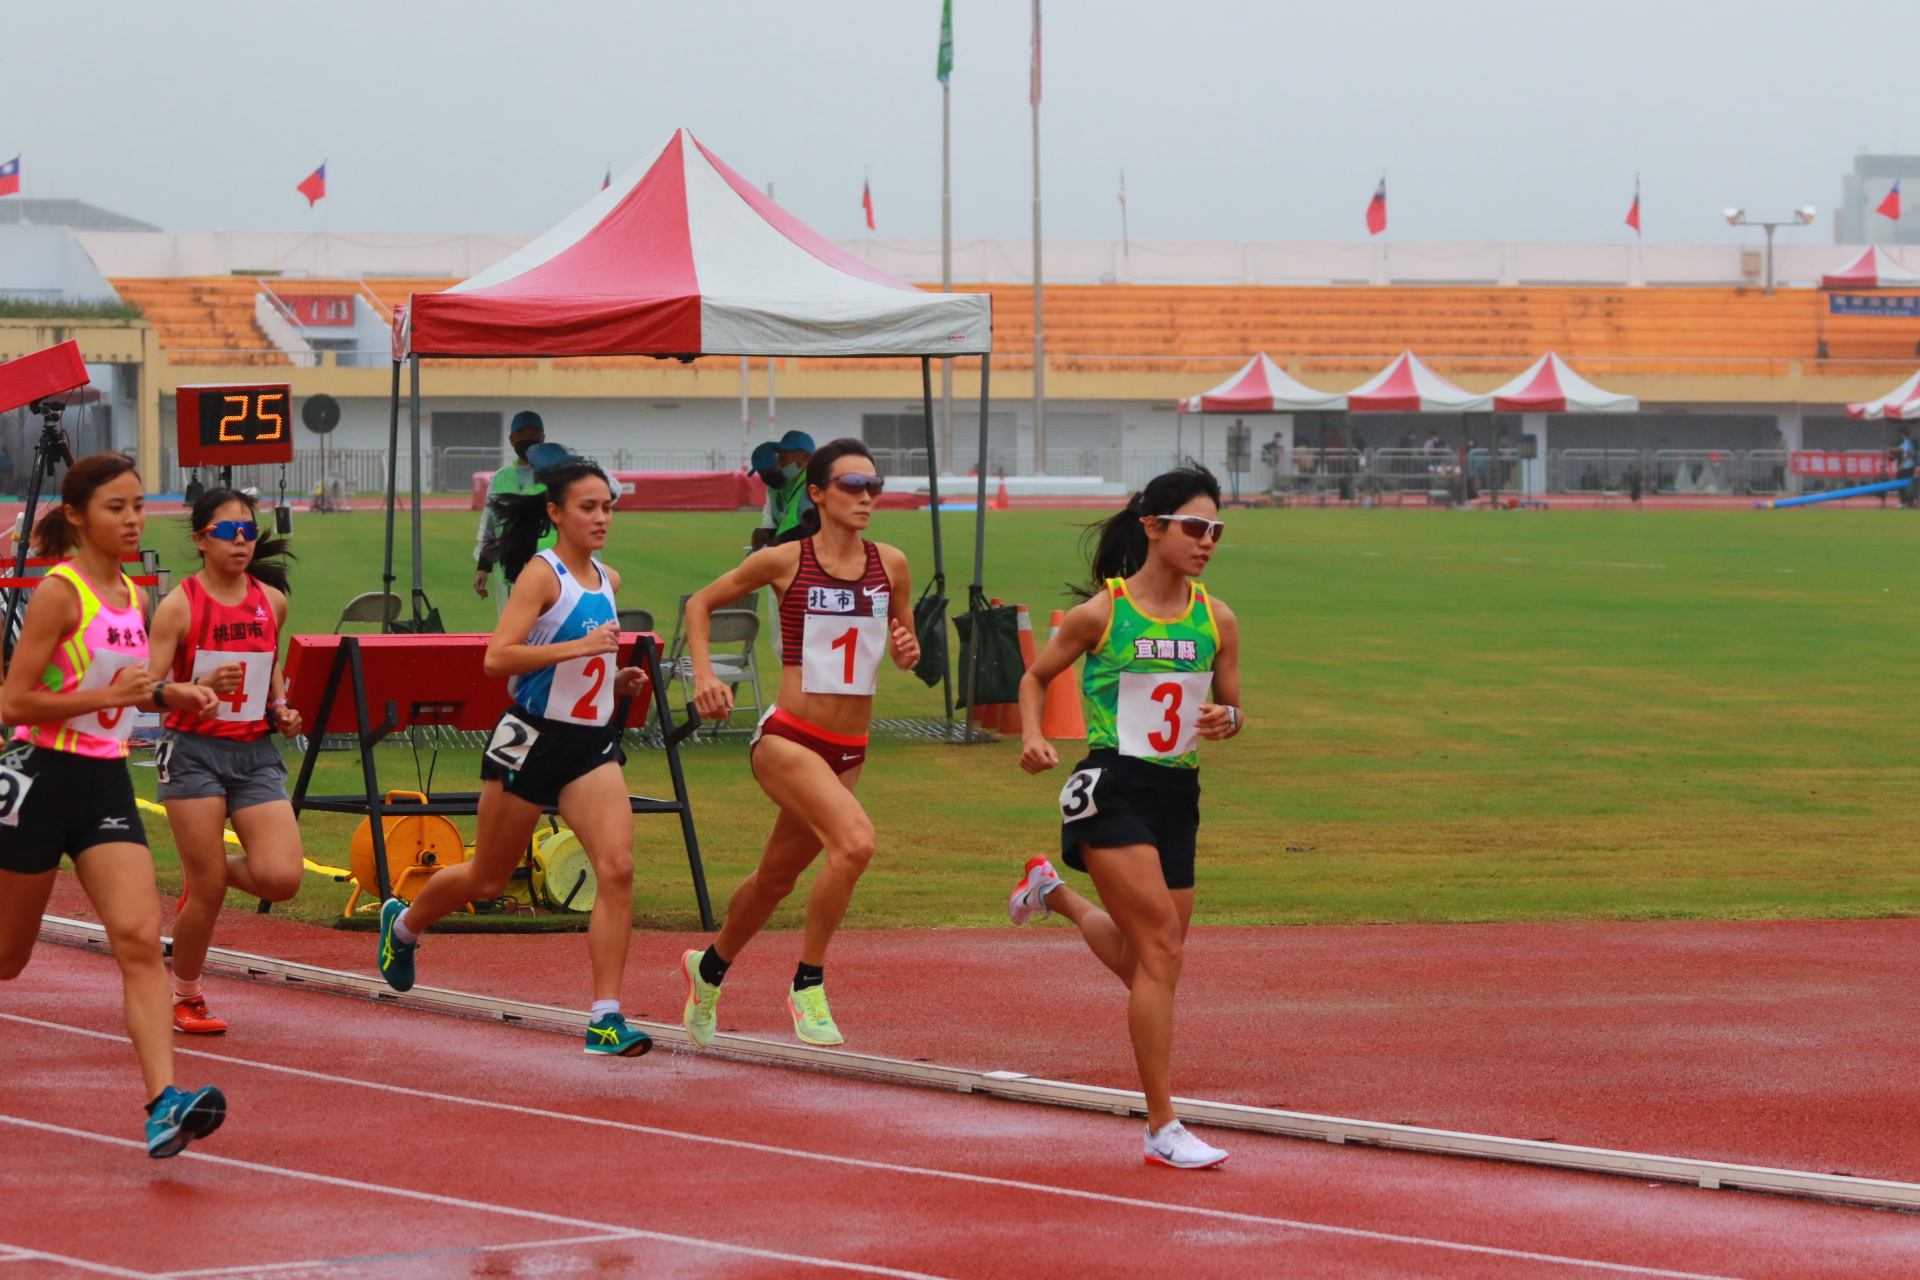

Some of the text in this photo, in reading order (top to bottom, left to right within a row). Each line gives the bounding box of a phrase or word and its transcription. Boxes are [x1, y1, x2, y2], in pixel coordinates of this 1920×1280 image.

[219, 393, 283, 441] 25
[809, 588, 852, 610] 北市
[107, 625, 147, 647] 新北市
[212, 621, 263, 643] 桃園市
[1134, 637, 1196, 661] 宜蘭縣
[831, 627, 859, 684] 1
[218, 661, 248, 713] 4
[570, 656, 606, 720] 2
[1147, 681, 1183, 753] 3
[490, 721, 528, 765] 2
[1062, 773, 1093, 817] 3
